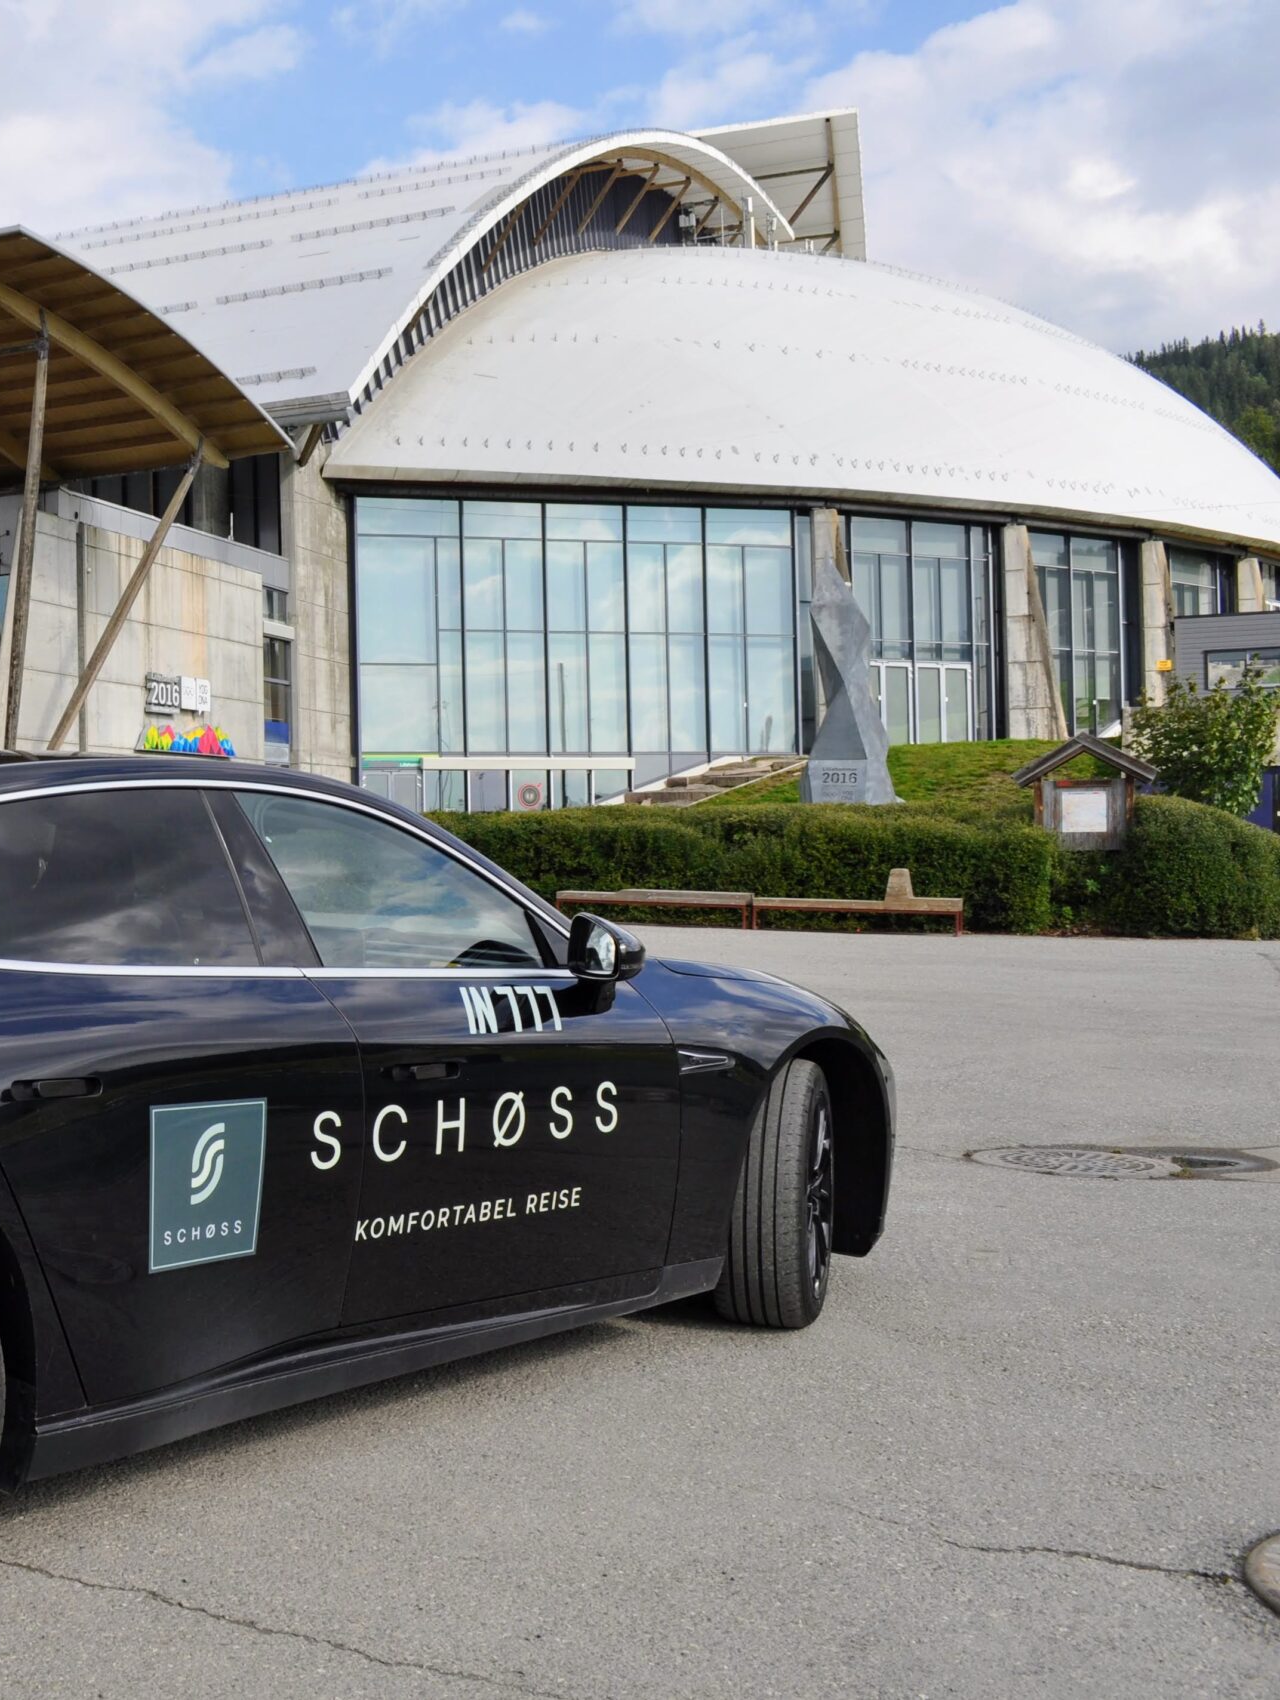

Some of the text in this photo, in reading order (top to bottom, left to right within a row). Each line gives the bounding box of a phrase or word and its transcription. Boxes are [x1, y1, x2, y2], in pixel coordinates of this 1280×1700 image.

[151, 682, 180, 706] 2016
[822, 772, 857, 784] 2016
[459, 985, 563, 1035] IN 777
[311, 1080, 619, 1170] SCHØSS
[163, 1219, 243, 1246] SCHØSS
[354, 1186, 583, 1242] KOMFORTABEL REISE
